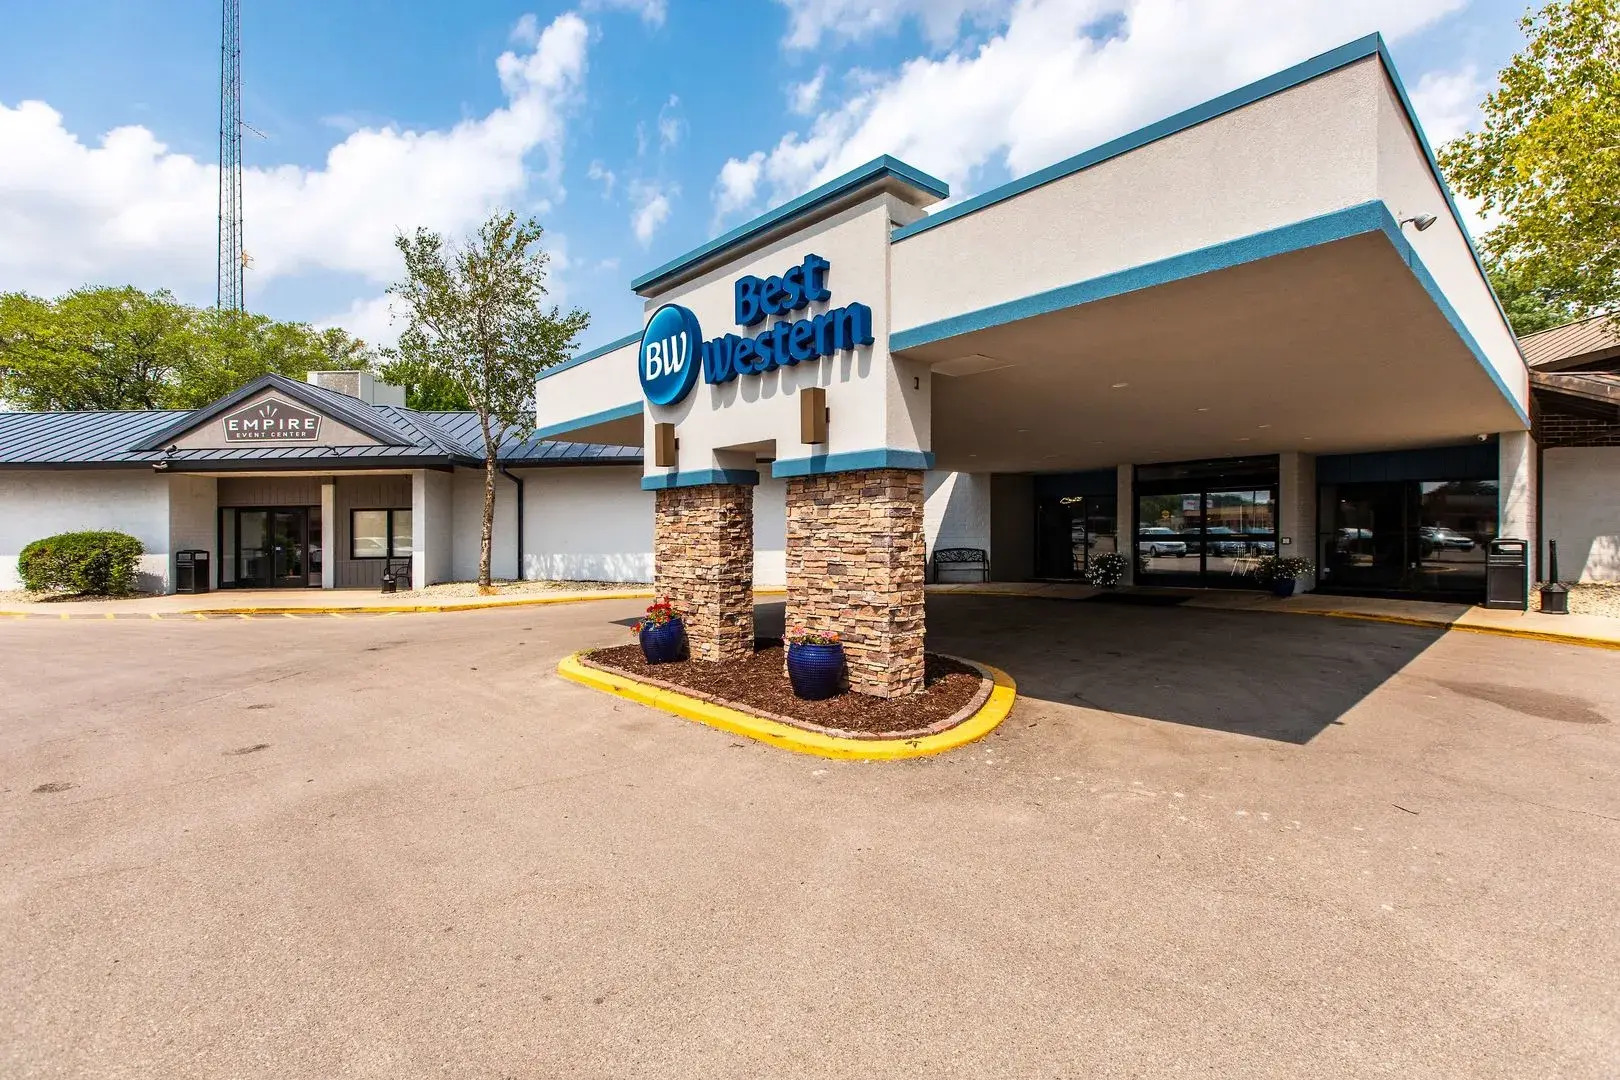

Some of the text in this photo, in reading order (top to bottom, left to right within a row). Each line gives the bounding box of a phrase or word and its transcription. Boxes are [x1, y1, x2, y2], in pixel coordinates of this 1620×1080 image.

[735, 253, 831, 326] Best
[645, 331, 687, 381] BW
[702, 302, 875, 384] Western
[228, 418, 315, 431] EMPIRE
